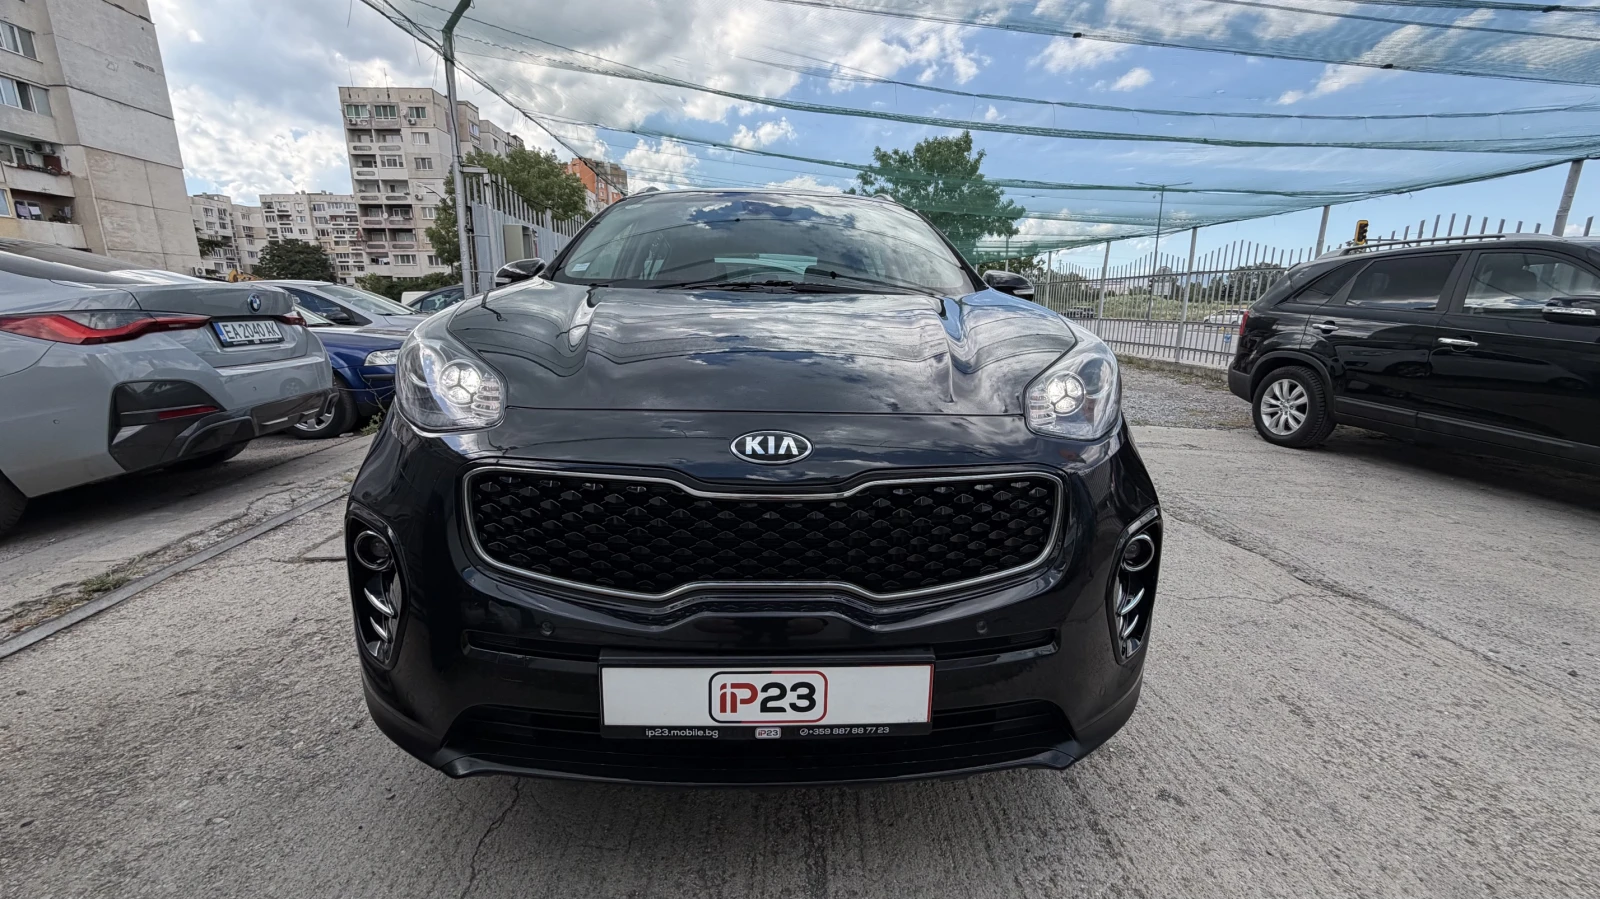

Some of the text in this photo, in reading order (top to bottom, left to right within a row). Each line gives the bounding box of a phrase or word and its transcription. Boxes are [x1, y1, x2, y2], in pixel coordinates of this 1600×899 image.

[222, 322, 280, 339] EA 2040 AK
[745, 436, 799, 455] KIA
[645, 728, 719, 739] ip23.mobile.bg
[851, 727, 864, 735] 88
[865, 726, 877, 734] 77
[877, 726, 890, 734] 23
